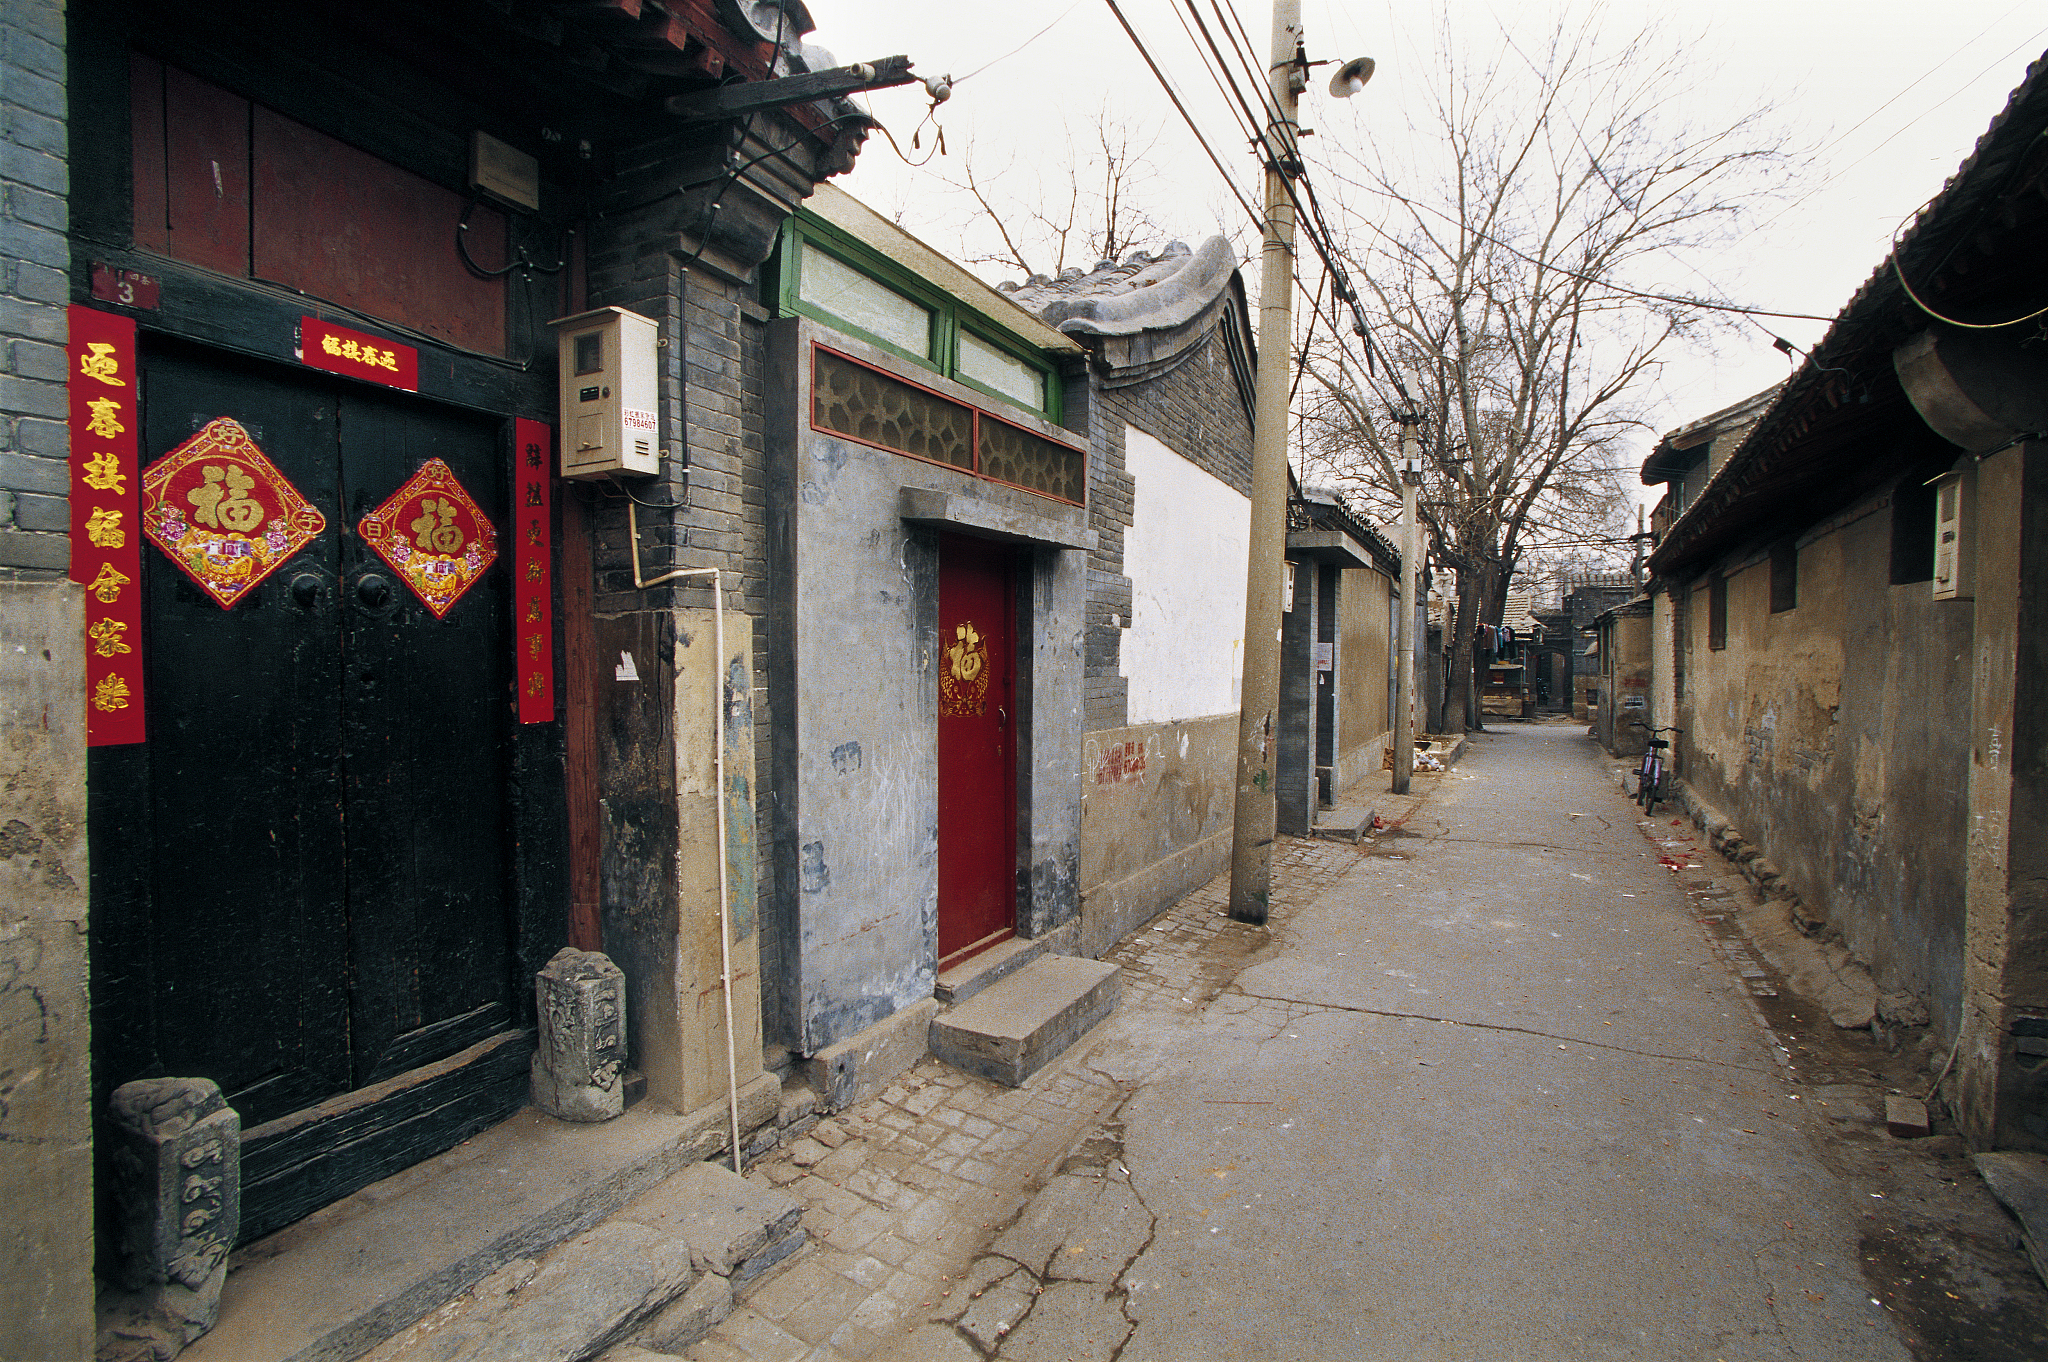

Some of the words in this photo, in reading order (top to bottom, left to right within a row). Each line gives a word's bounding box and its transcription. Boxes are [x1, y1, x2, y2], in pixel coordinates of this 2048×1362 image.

[117, 282, 134, 303] 3
[212, 425, 244, 445] 好
[427, 466, 449, 481] 好
[186, 464, 265, 533] 福
[297, 514, 322, 530] 子
[366, 522, 382, 537] 日
[410, 496, 465, 554] 福
[949, 620, 981, 682] 福
